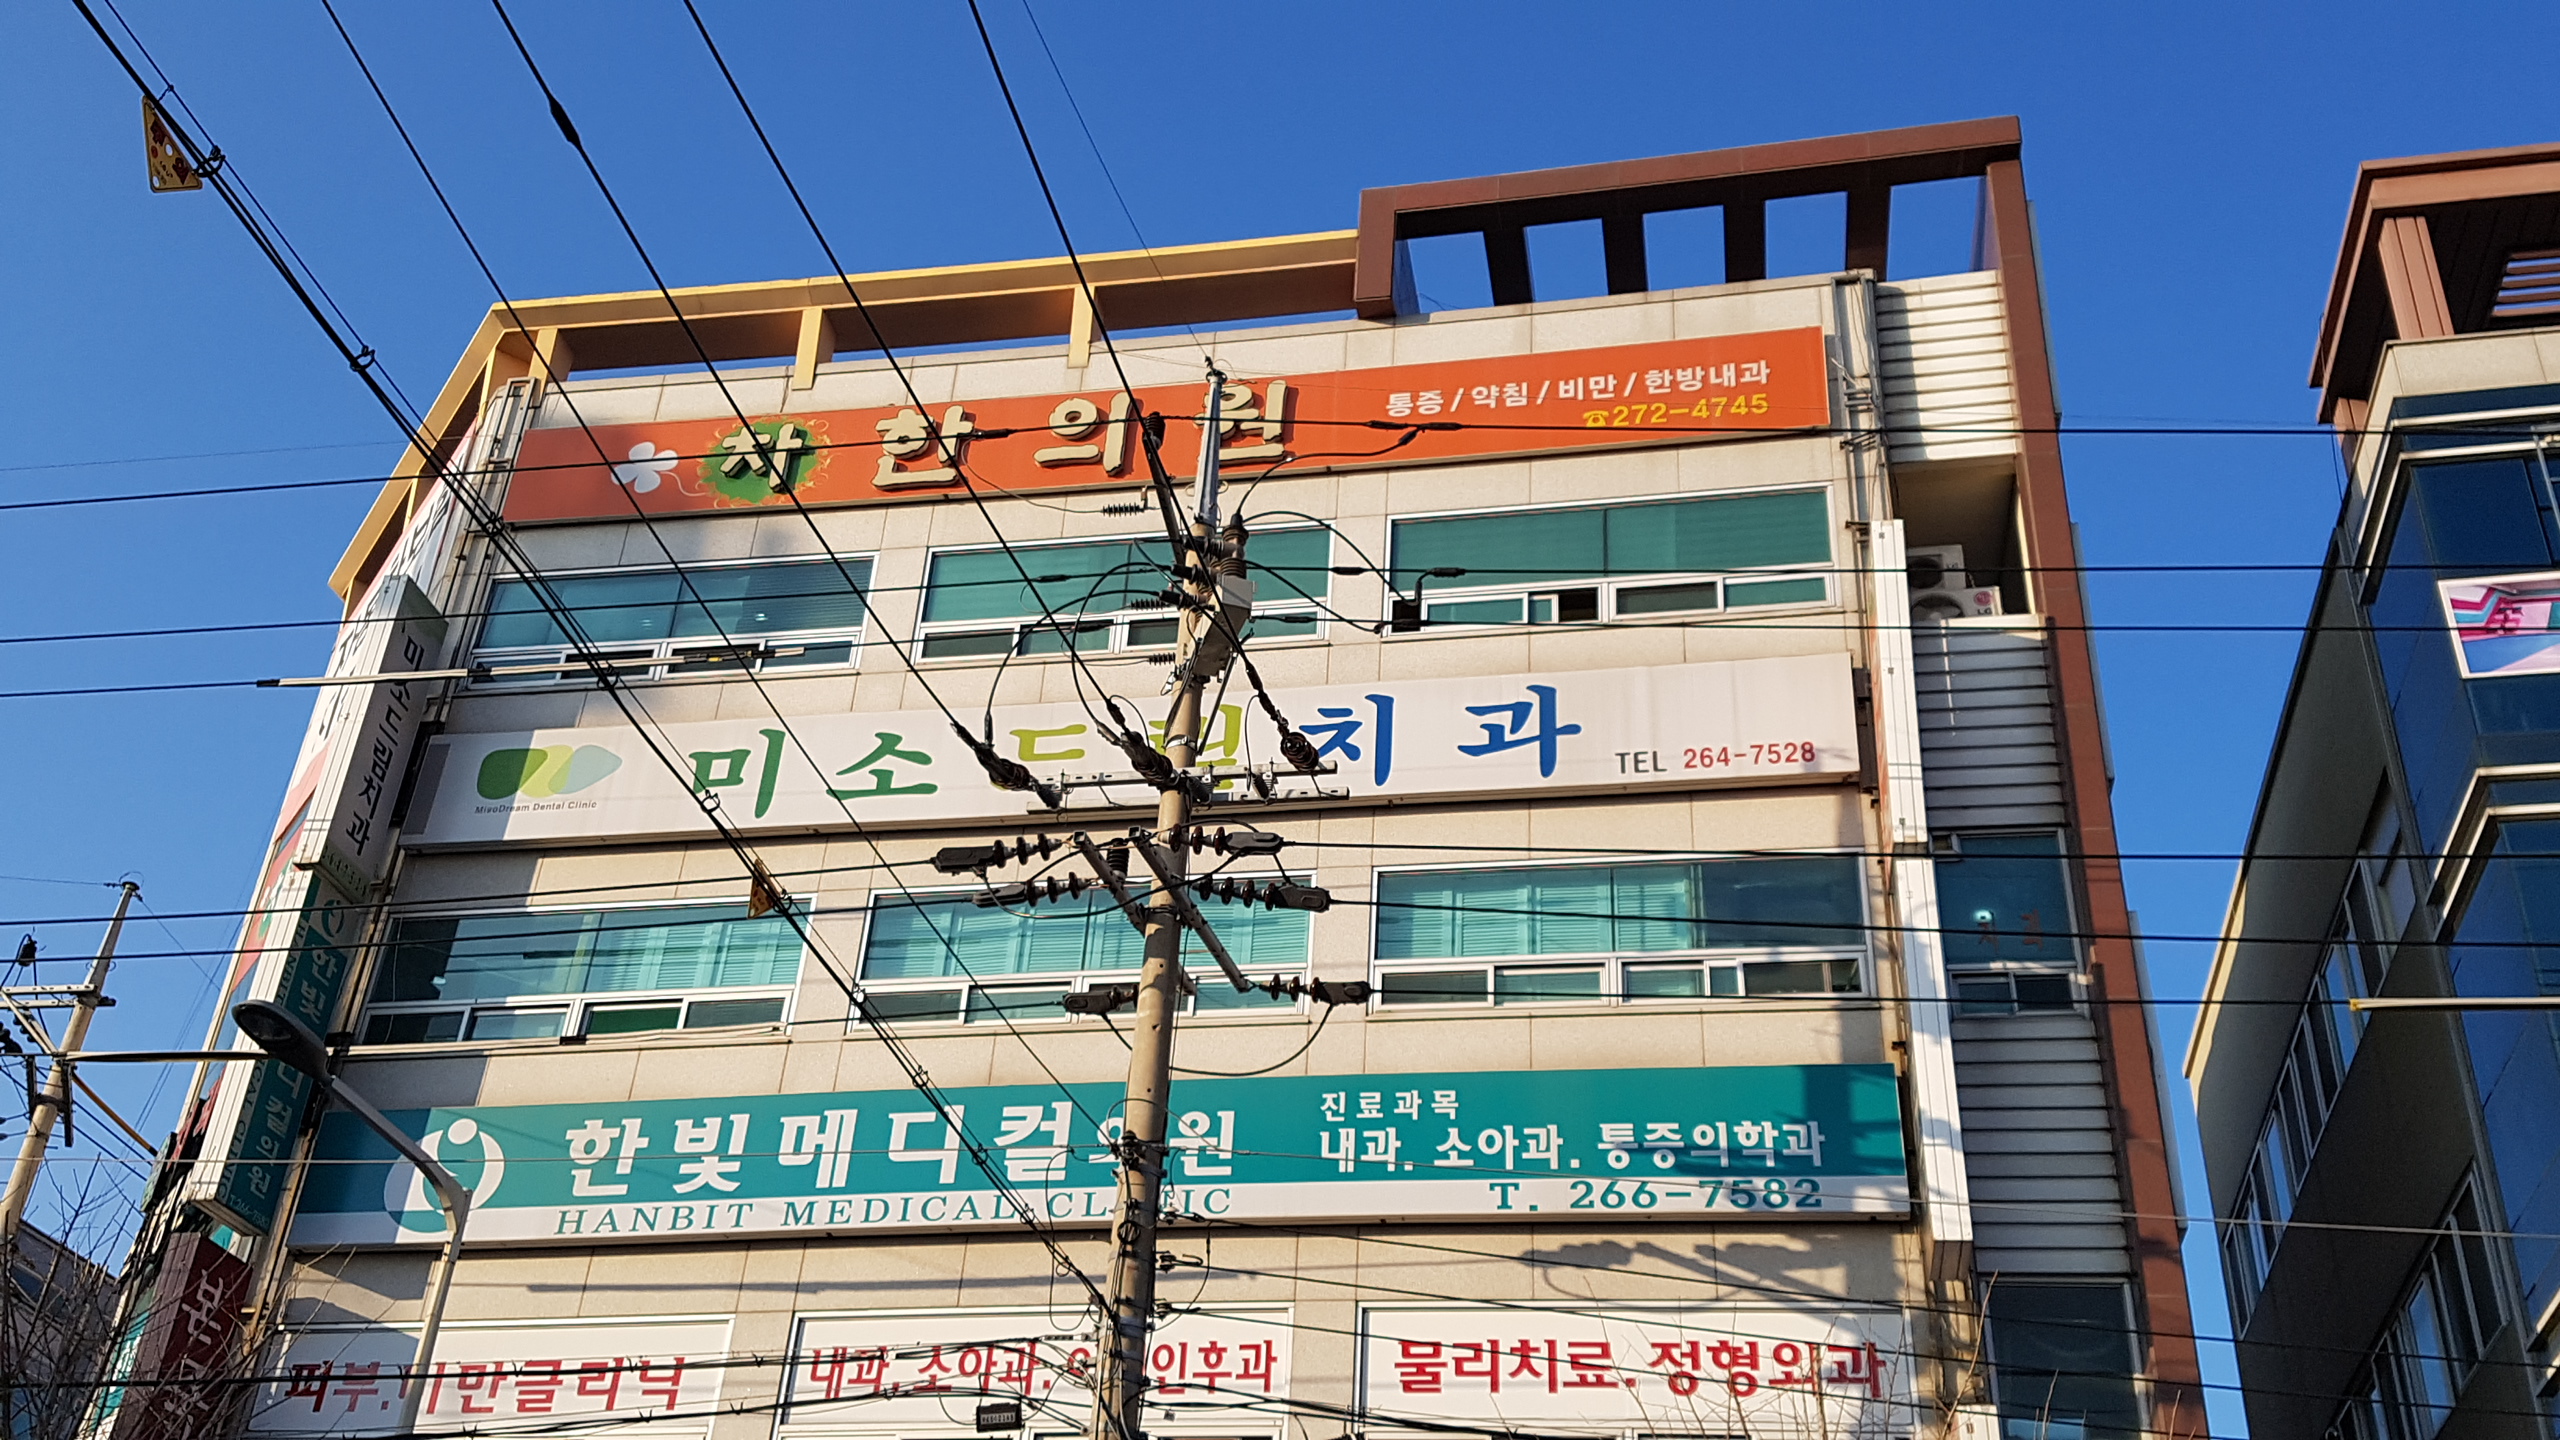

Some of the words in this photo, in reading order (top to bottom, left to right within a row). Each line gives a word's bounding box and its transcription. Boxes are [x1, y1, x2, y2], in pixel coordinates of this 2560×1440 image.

[1644, 360, 1771, 395] 한방내과
[1613, 393, 1769, 427] 272-4745
[1615, 751, 1668, 774] TEL
[1682, 742, 1815, 771] 264-7528
[533, 802, 565, 812] Dental
[567, 799, 597, 810] Clinic
[247, 944, 338, 1200] 한빛디컬의원
[1320, 1090, 1460, 1123] 진료과목
[1598, 1120, 1826, 1169] 통증의학과
[1570, 1179, 1823, 1209] 266-7582
[554, 1203, 755, 1235] HANBIT
[779, 1192, 1017, 1227] MEDICAL
[1048, 1188, 1232, 1220] CLIC
